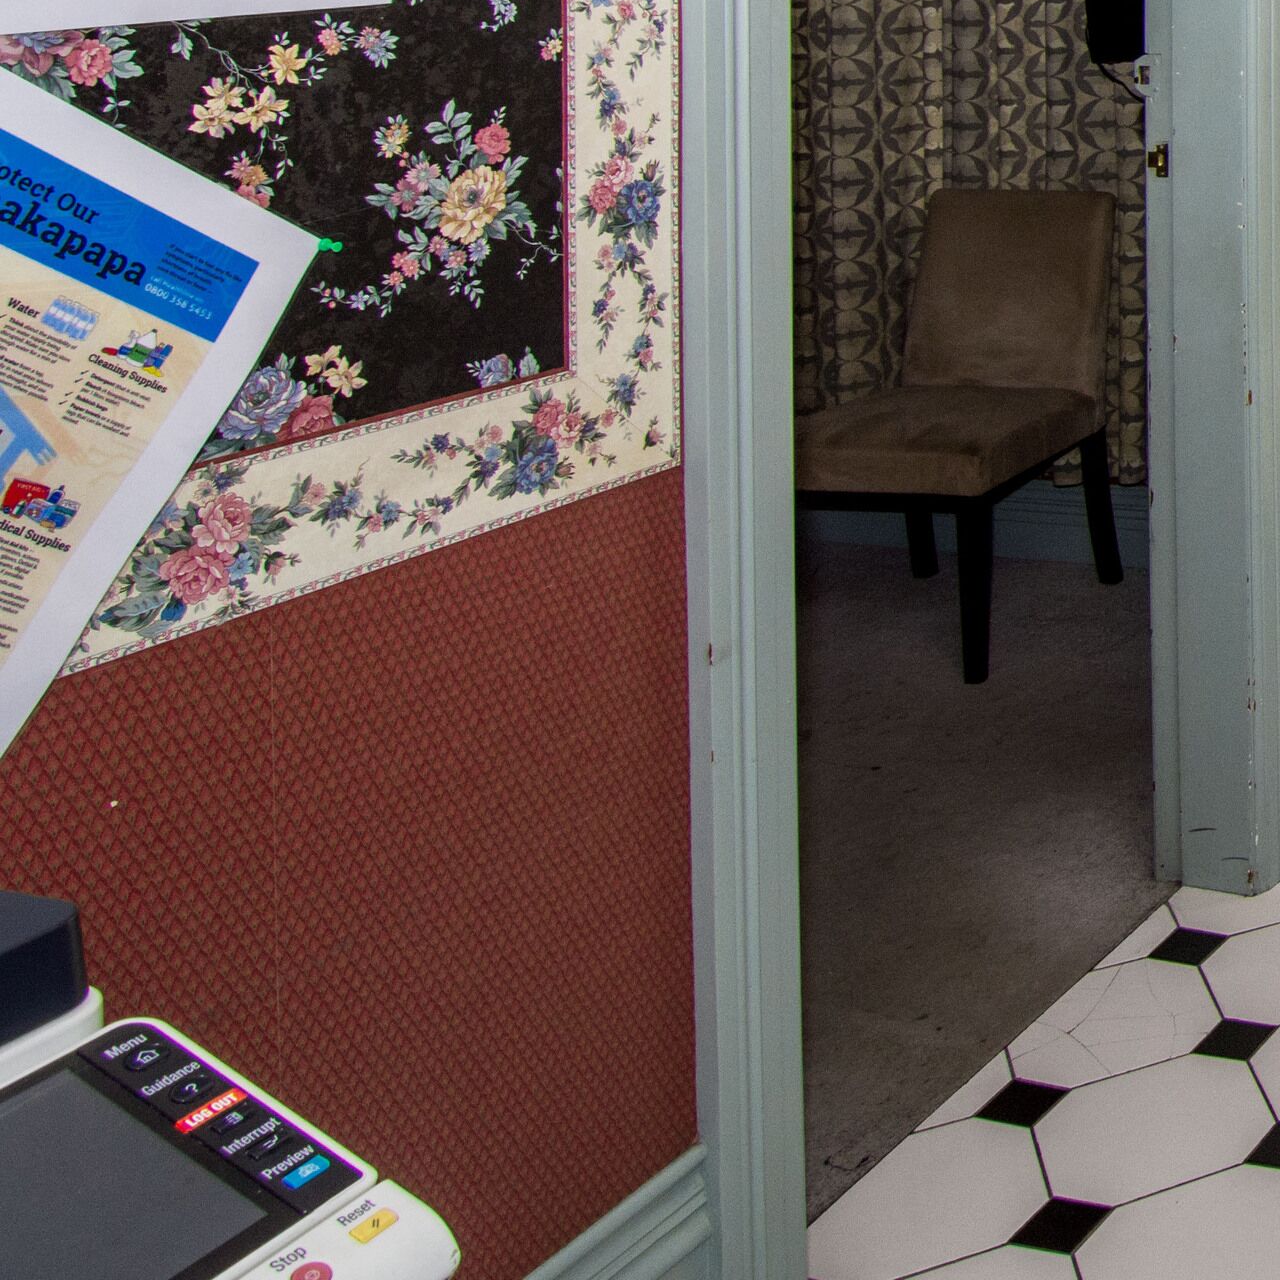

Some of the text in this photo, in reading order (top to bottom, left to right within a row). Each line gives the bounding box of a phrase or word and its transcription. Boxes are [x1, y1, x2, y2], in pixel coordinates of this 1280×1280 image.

[57, 193, 100, 224] Our
[7, 297, 41, 318] Water
[144, 283, 213, 320] 0800 358 5453
[88, 353, 168, 393] Cleaning Supplies
[25, 529, 71, 552] Supplies
[104, 1033, 148, 1059] Menu
[141, 1061, 201, 1096] Guidance
[185, 1093, 238, 1127] LOG OUT
[222, 1117, 281, 1154] Interrupt
[261, 1144, 315, 1180] Preview
[336, 1199, 376, 1227] Reset
[270, 1246, 307, 1273] Stop
